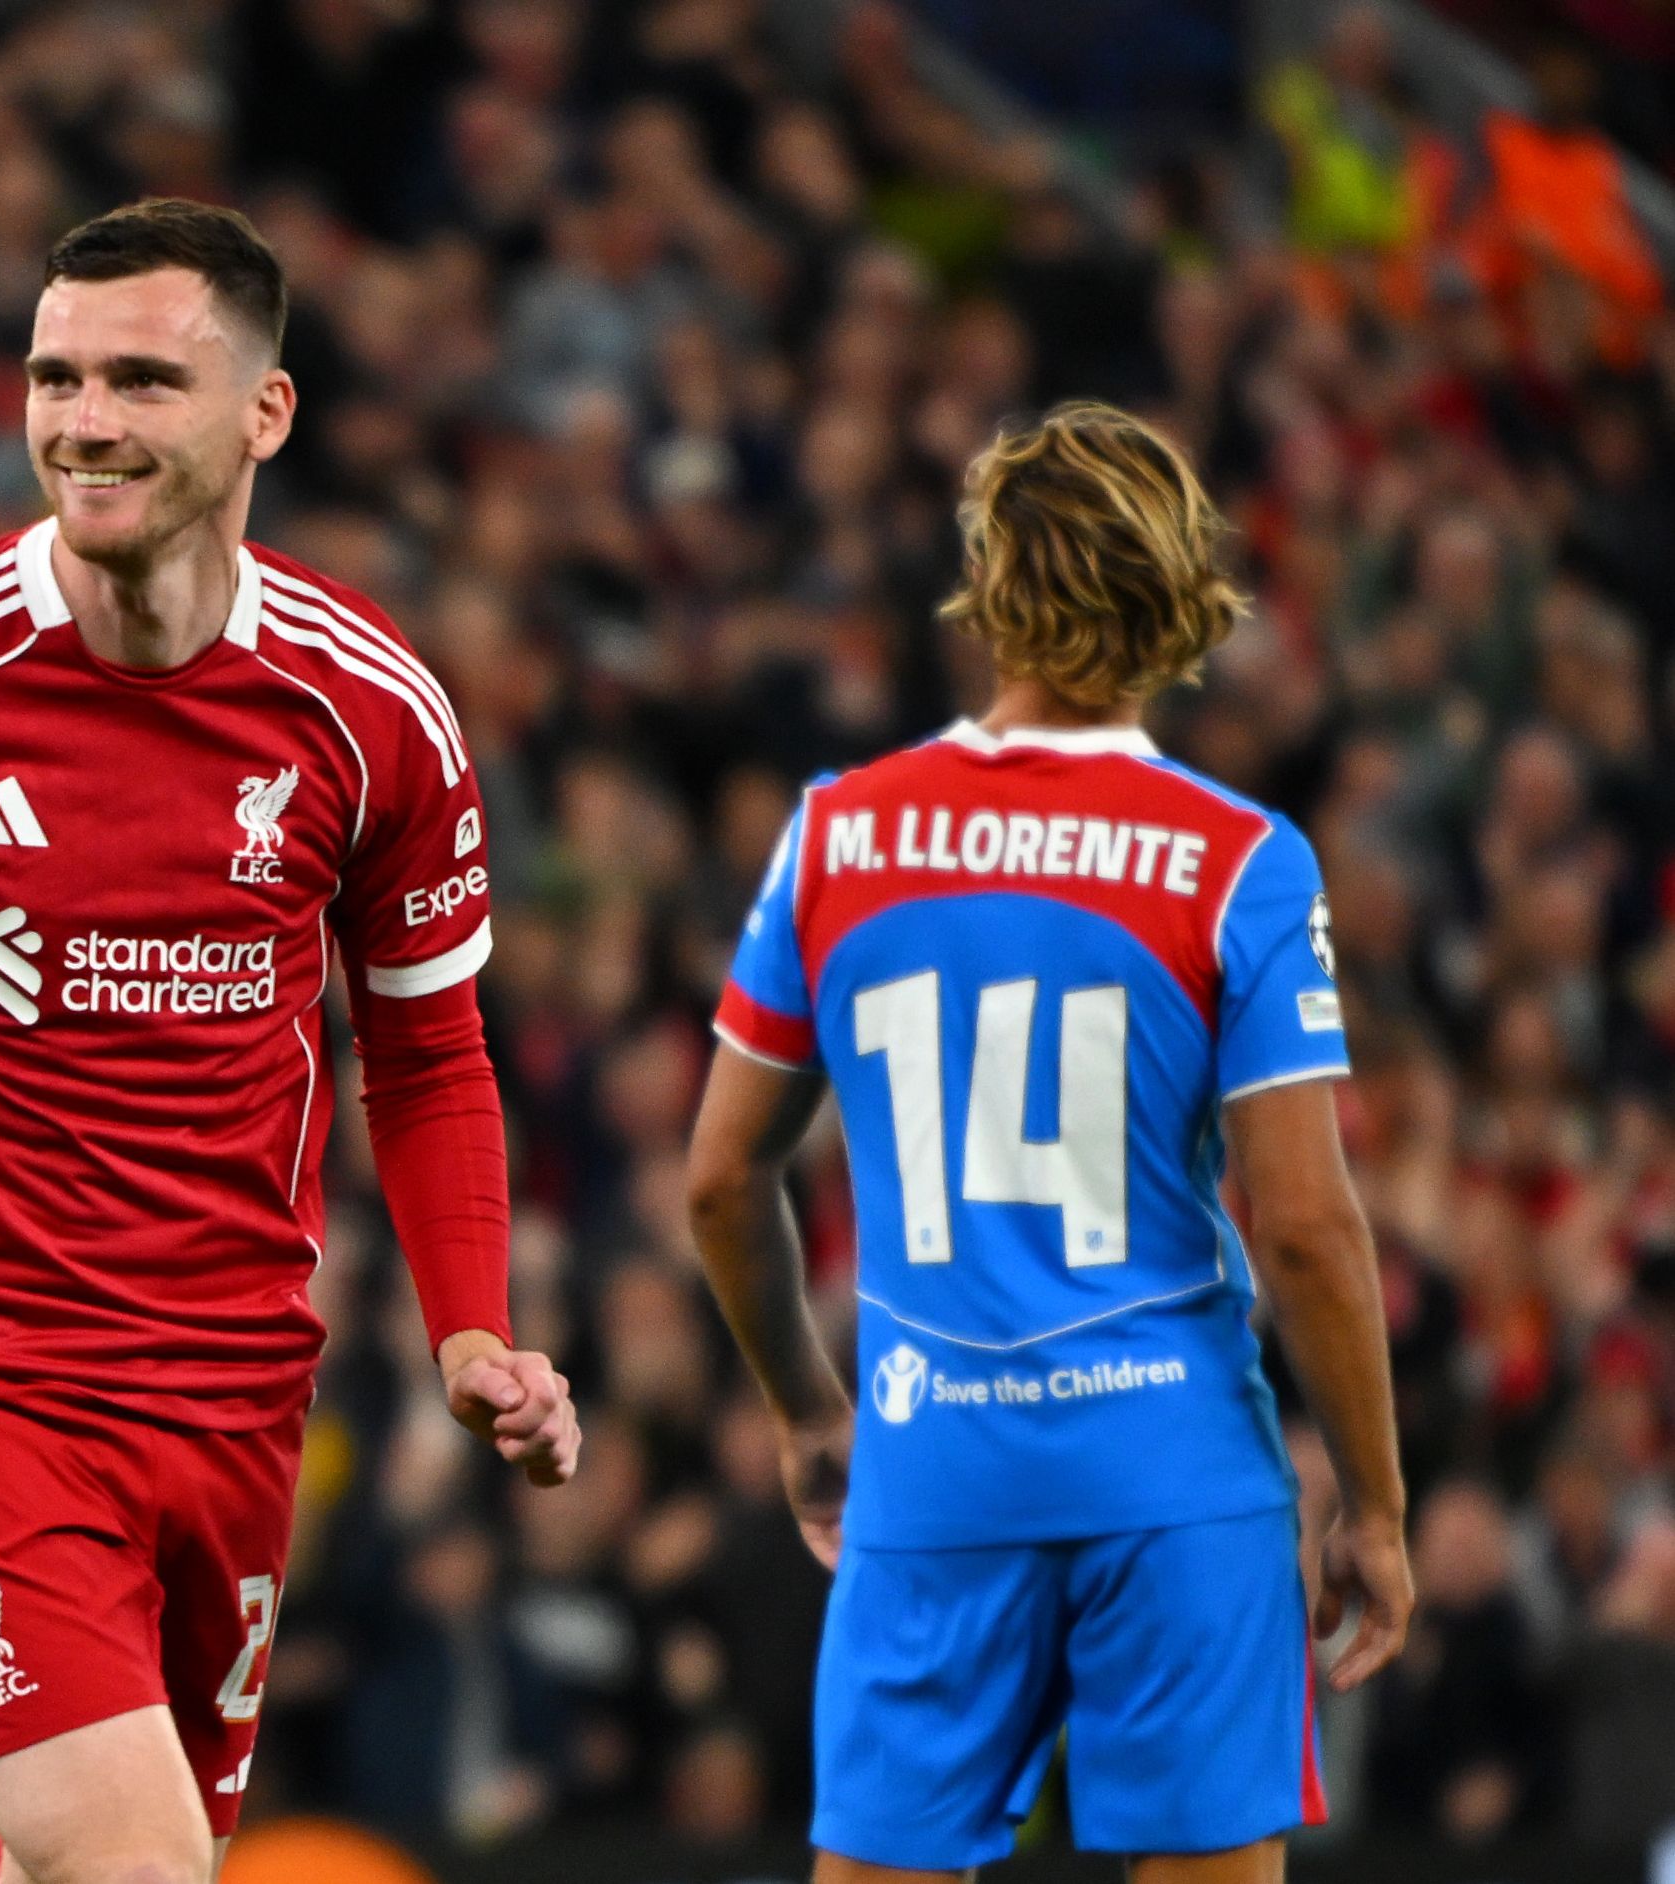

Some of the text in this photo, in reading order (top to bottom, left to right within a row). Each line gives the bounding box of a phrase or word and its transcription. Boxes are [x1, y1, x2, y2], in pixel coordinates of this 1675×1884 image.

[828, 810, 1206, 896] M. LLORENTE
[404, 865, 488, 927] Expe
[63, 930, 276, 973] standard
[61, 967, 275, 1014] chartered
[854, 968, 1127, 1267] 14
[932, 1357, 1185, 1404] Save the Children
